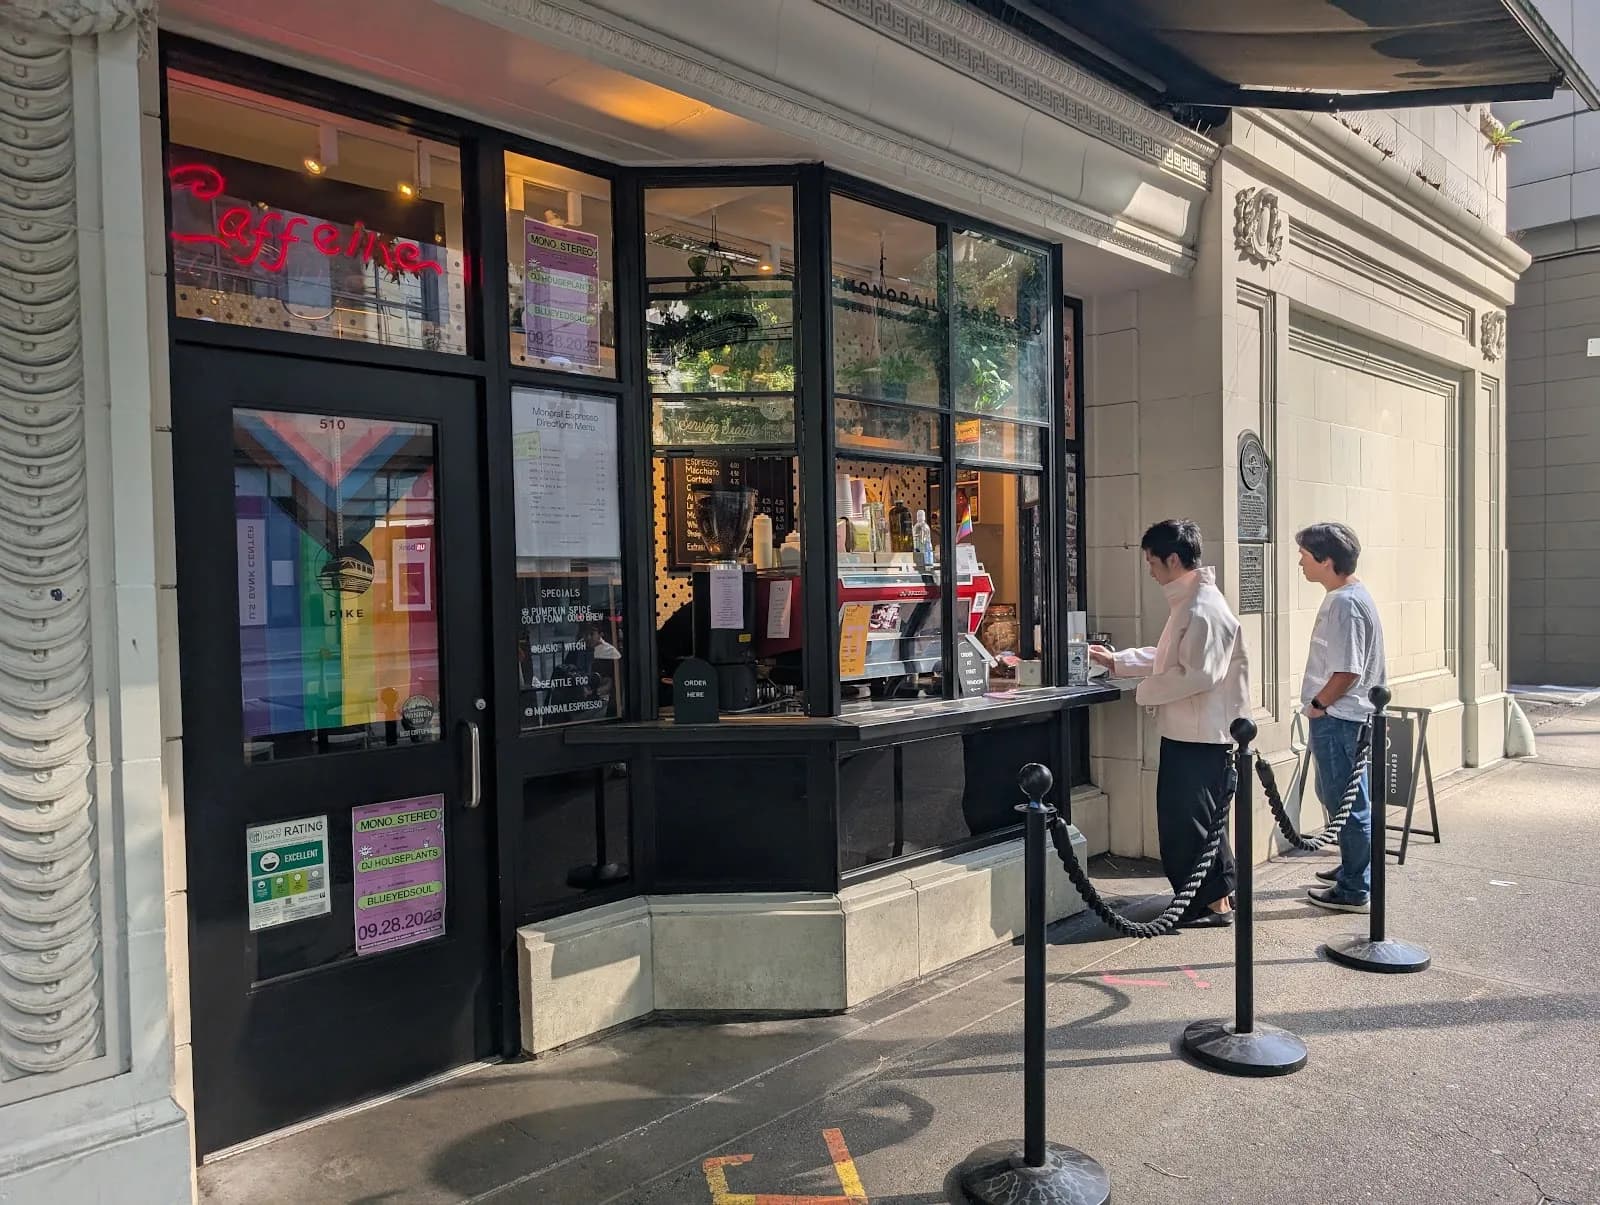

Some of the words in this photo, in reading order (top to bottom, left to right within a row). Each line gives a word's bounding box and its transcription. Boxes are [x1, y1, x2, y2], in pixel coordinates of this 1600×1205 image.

[532, 407, 564, 418] Monorail
[565, 410, 599, 422] Espresso
[319, 419, 346, 430] 510
[574, 422, 596, 432] Menu
[685, 457, 719, 468] Espresso
[685, 466, 720, 476] Macchiato
[686, 475, 713, 484] Cortado
[541, 588, 581, 599] SPECIALS
[329, 608, 365, 618] PIKE
[531, 605, 566, 616] PUMPKIN
[568, 605, 592, 614] SPICE
[521, 615, 541, 625] COLD
[543, 614, 563, 624] FOAM
[586, 612, 604, 621] BREW
[564, 641, 587, 651] WITCH
[541, 677, 572, 689] SEATTLE
[575, 676, 589, 686] FOG
[524, 700, 603, 717] @MONORAILESPRESSO
[1390, 753, 1398, 794] ESPRESSO
[284, 822, 323, 837] RATING
[284, 849, 319, 863] EXCELLENT
[361, 860, 373, 870] DJ
[375, 848, 438, 867] HOUSEPLANTS
[367, 885, 433, 906] BLUEYEDSOUL
[358, 907, 442, 941] 09.28.2025
